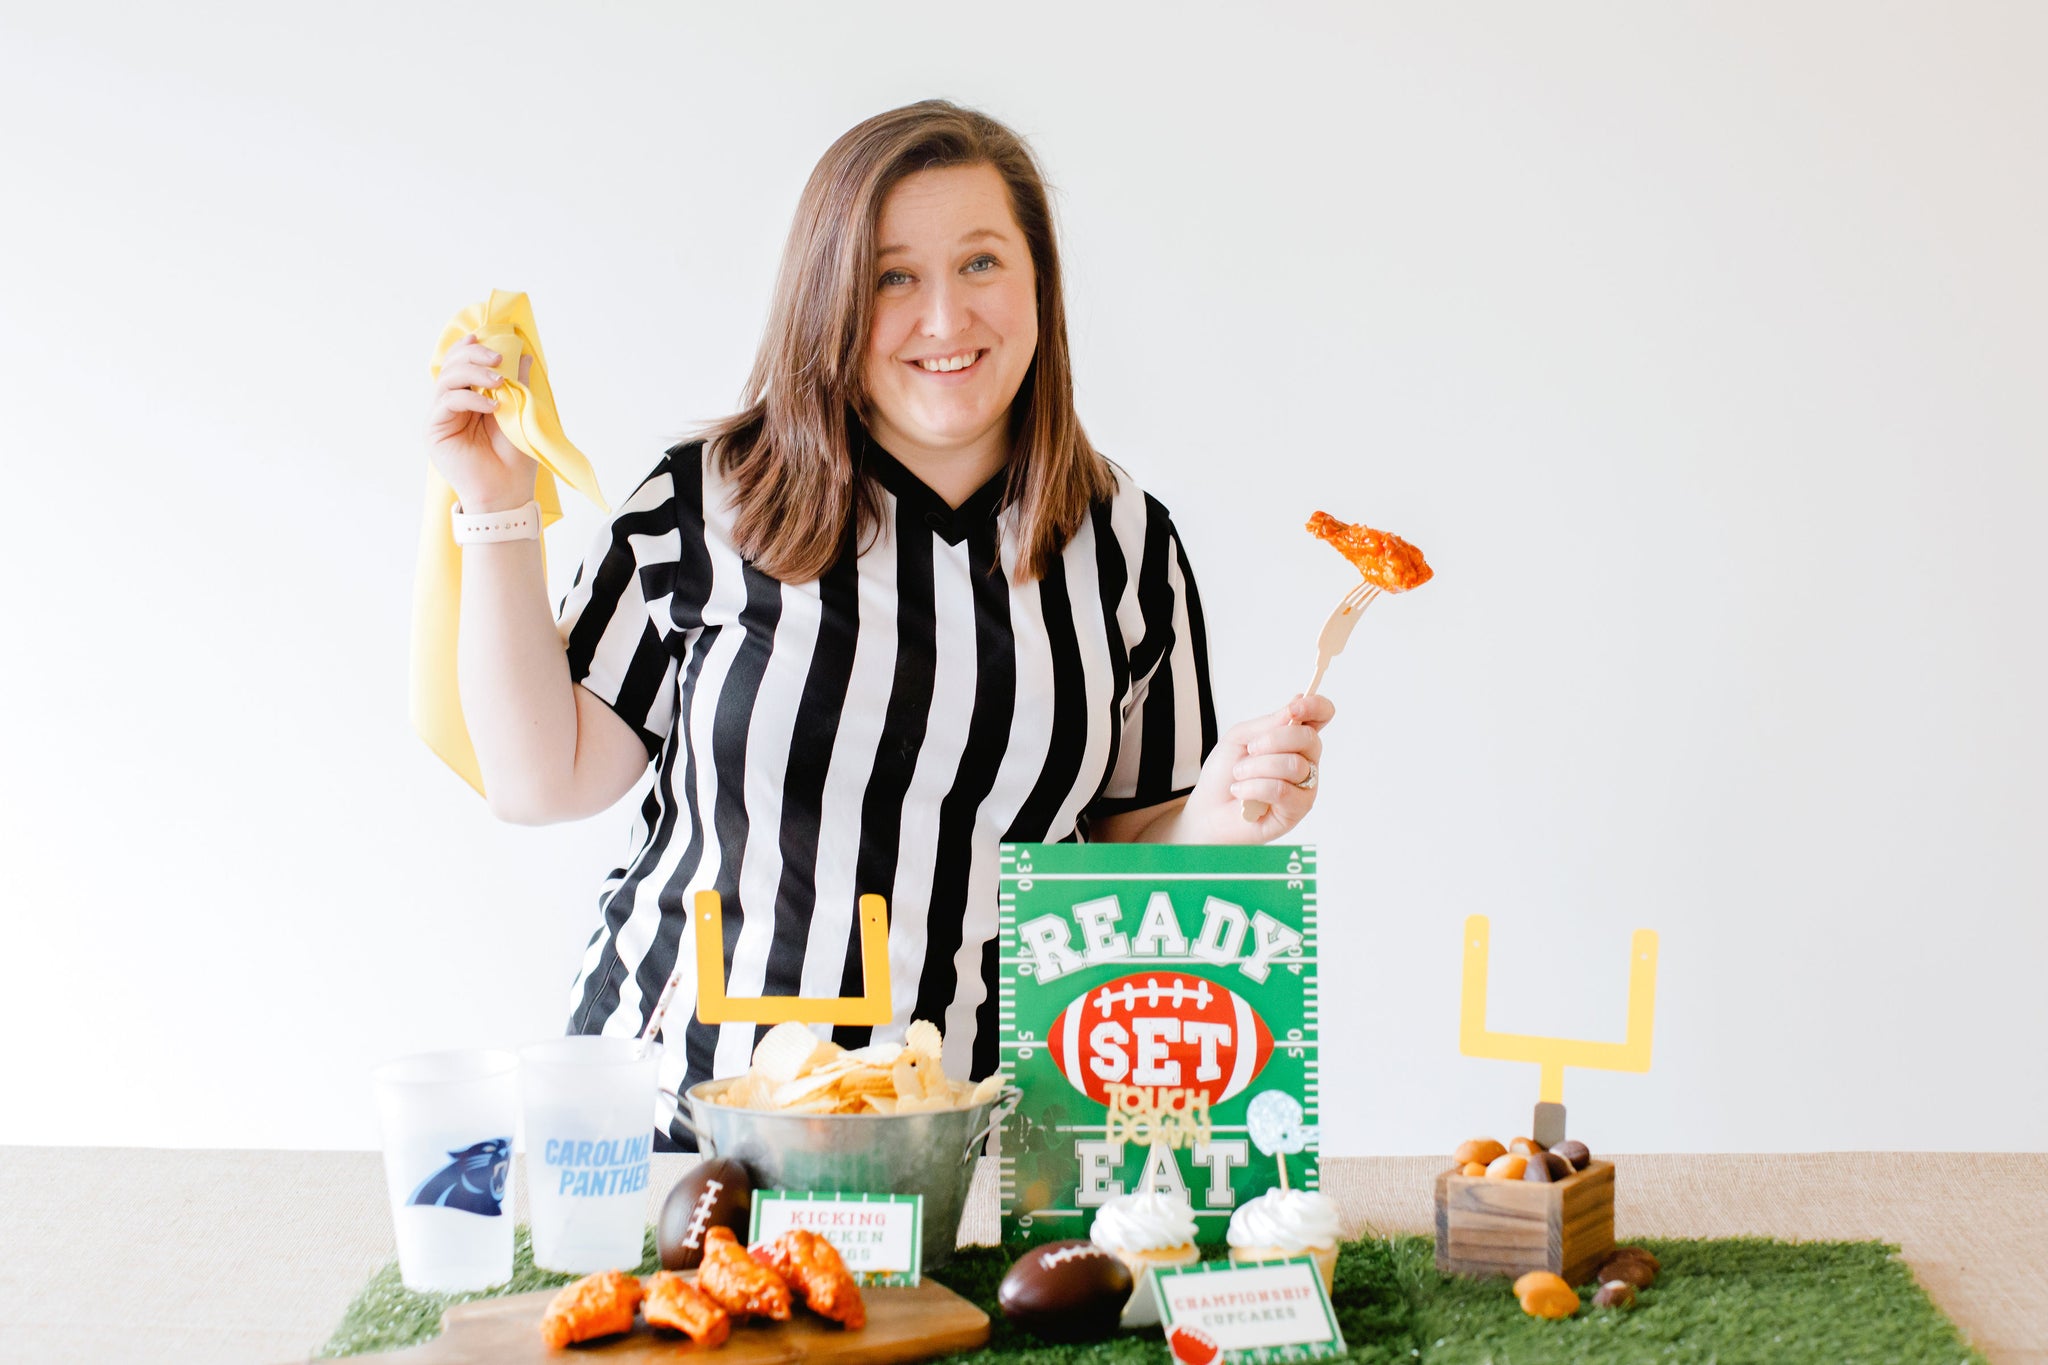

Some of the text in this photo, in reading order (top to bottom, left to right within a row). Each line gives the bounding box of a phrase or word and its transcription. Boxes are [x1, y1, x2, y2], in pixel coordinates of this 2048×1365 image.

[1016, 861, 1033, 891] 30
[1286, 861, 1304, 889] 30
[1017, 891, 1304, 985] READY
[1016, 1030, 1034, 1059] 50
[1089, 1017, 1232, 1086] SET
[1286, 1028, 1304, 1058] 50
[1103, 1082, 1210, 1118] TOUCH
[1106, 1111, 1212, 1149] DOWN
[1075, 1139, 1249, 1207] EAT
[791, 1210, 886, 1227] KICKING
[1174, 1286, 1312, 1311] CHAMPIONSHIP
[1202, 1306, 1297, 1327] CUPCAKES
